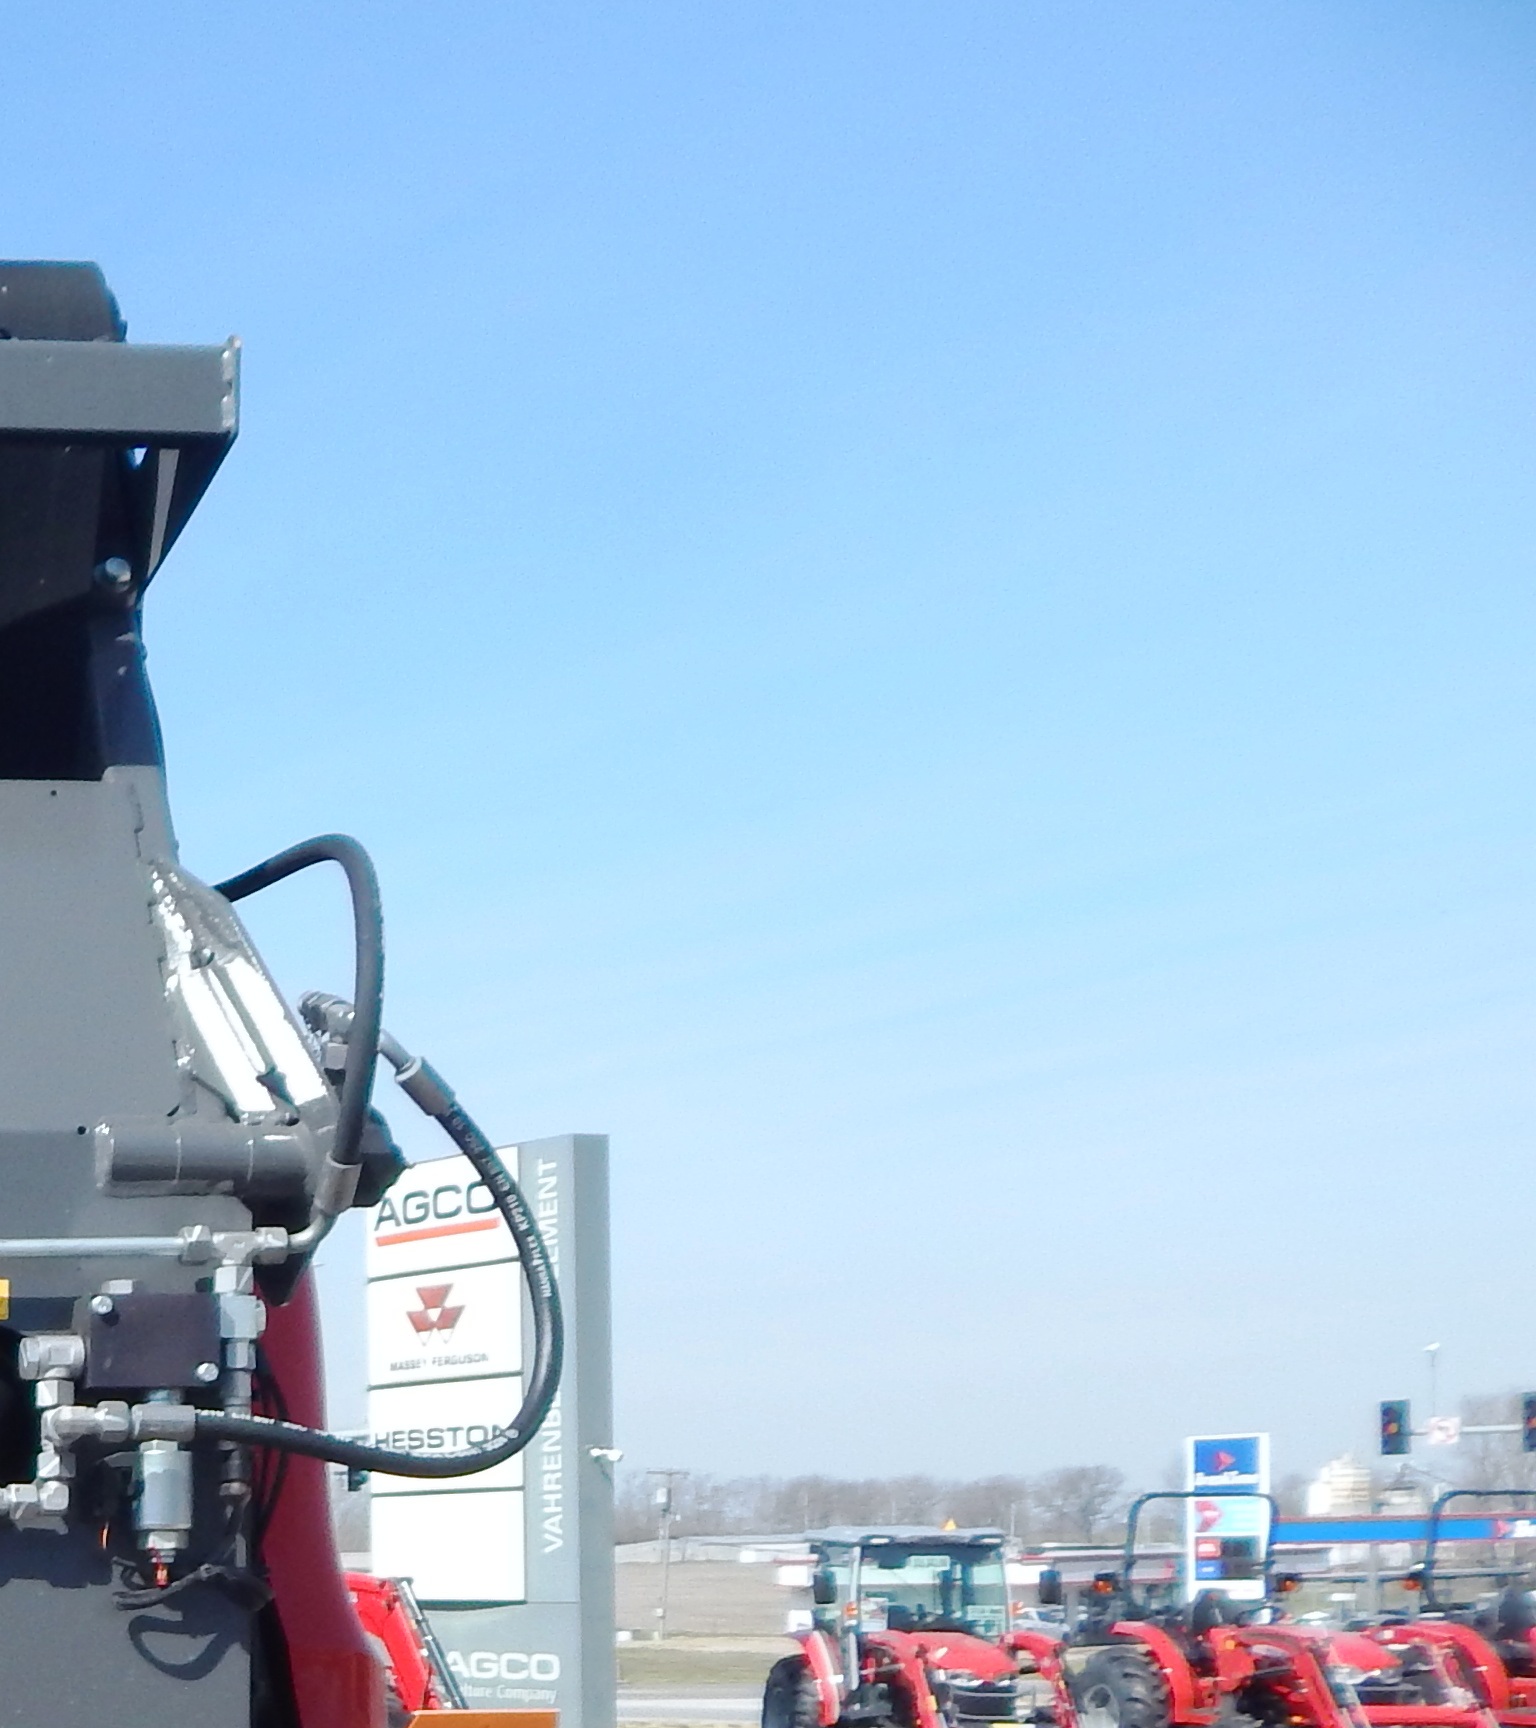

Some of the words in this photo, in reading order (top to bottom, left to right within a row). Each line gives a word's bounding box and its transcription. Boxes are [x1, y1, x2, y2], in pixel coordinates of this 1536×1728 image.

[374, 1180, 499, 1232] AGCO
[432, 1352, 489, 1366] FERGUSON
[542, 1390, 563, 1553] VAHRENB
[446, 1650, 561, 1681] AGCO
[497, 1684, 557, 1704] Company
